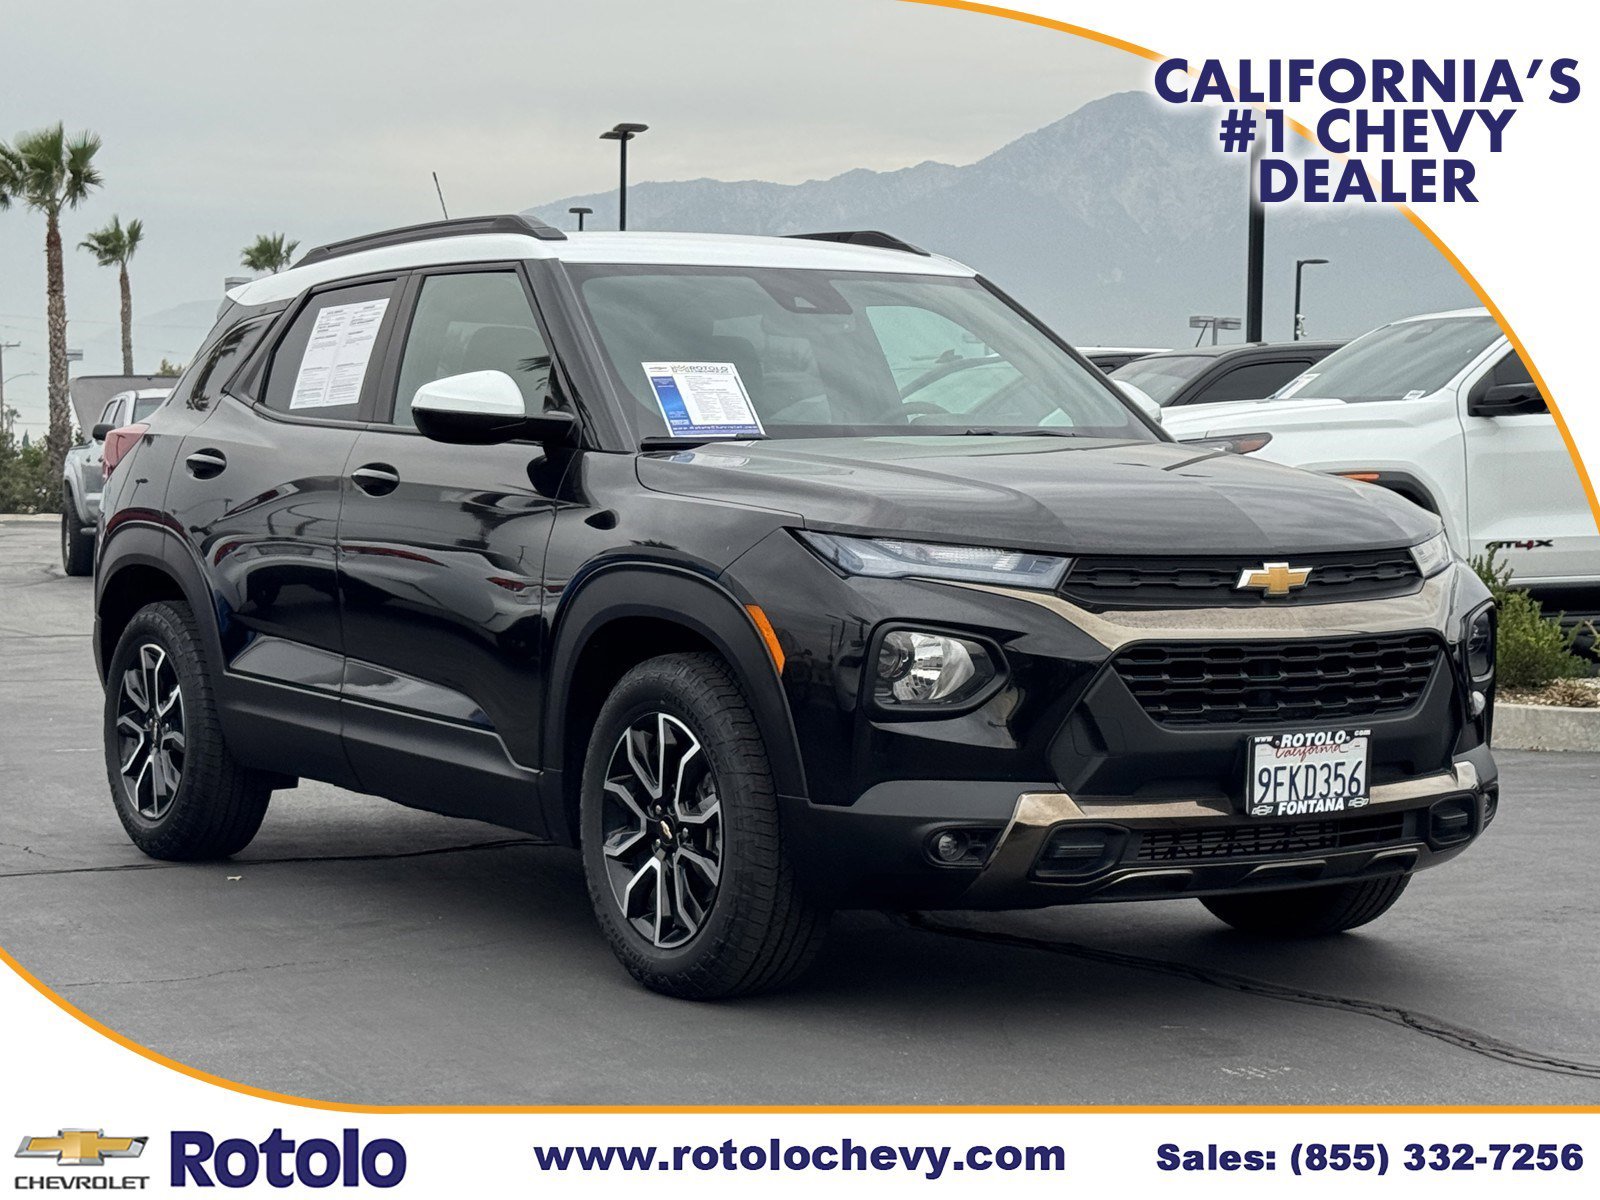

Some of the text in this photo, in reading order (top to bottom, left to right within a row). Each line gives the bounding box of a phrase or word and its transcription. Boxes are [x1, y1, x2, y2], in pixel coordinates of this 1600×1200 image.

[1280, 730, 1347, 748] ROTOLO
[1275, 744, 1349, 762] California
[1258, 760, 1363, 803] 9FKD356
[1277, 797, 1345, 816] FONTANA
